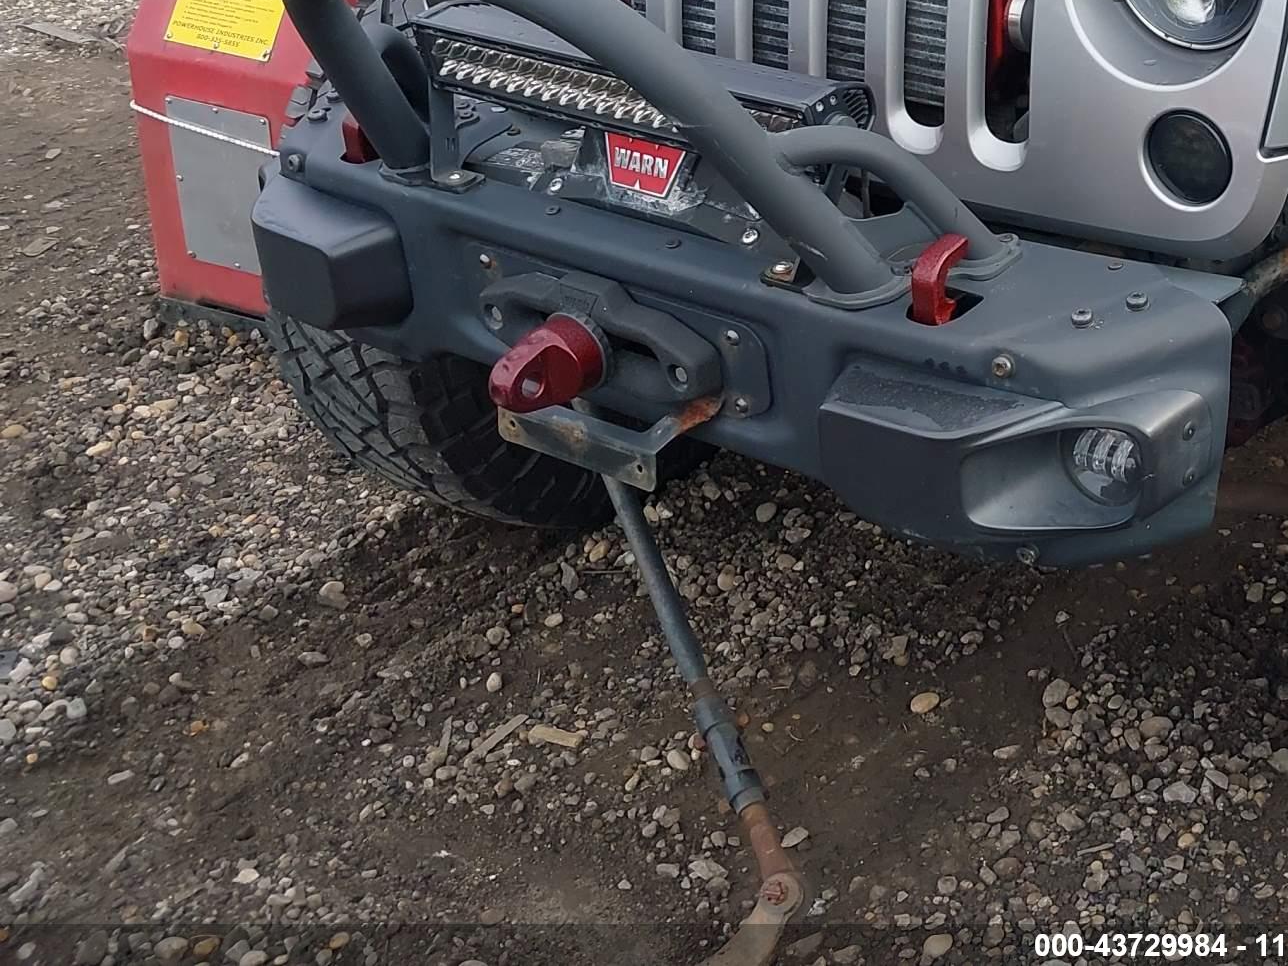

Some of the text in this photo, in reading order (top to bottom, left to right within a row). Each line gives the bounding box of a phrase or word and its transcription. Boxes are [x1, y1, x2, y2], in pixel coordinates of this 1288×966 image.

[172, 20, 217, 35] POWERHOUSE
[216, 28, 255, 43] INDUSTRIES
[613, 146, 670, 179] WARN
